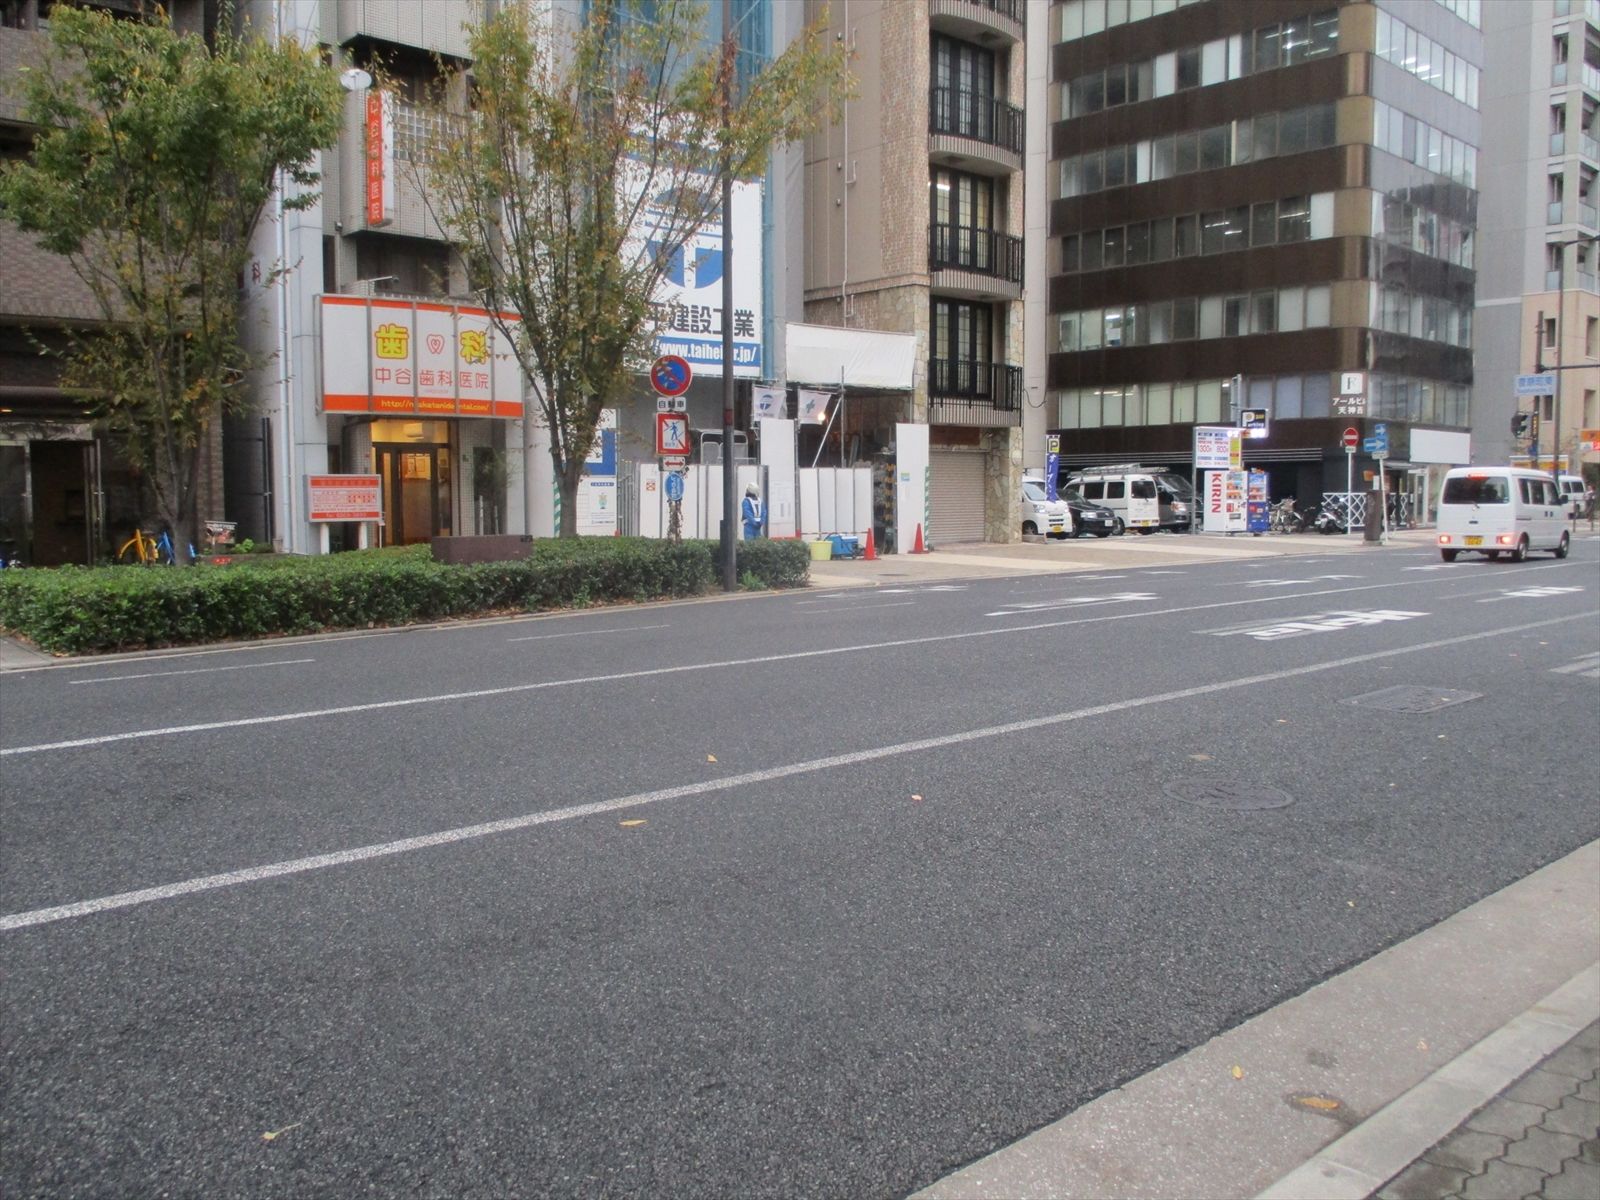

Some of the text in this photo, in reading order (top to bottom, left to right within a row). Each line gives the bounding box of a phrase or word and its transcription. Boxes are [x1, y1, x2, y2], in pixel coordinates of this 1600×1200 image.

[369, 100, 381, 220] 中谷歯科医院
[375, 323, 491, 365] 歯 科
[375, 367, 490, 390] 中谷歯科医院
[1211, 473, 1222, 513] KIRIN
